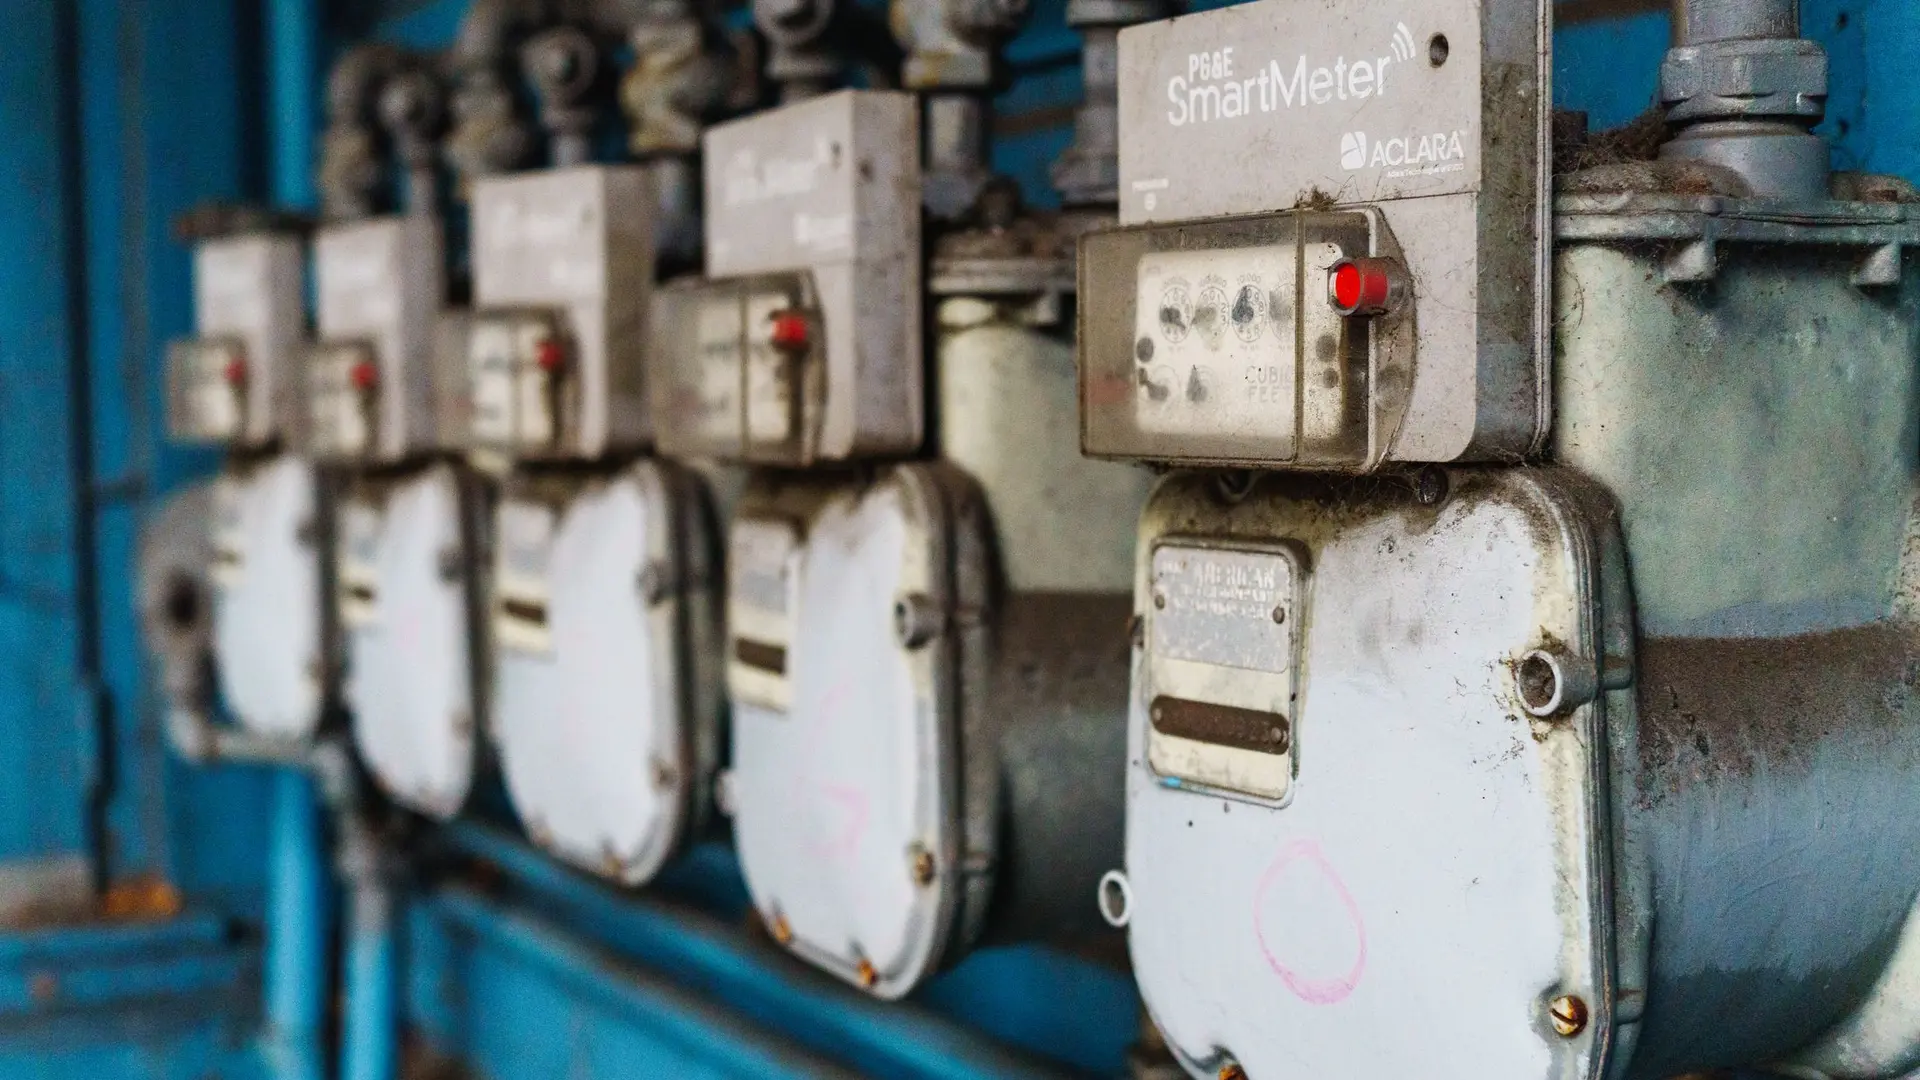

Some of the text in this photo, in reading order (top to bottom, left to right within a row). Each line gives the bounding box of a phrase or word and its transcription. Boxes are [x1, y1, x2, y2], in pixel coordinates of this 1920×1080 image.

[1189, 47, 1233, 82] PG&E
[1168, 55, 1391, 126] SmartMeter
[1370, 130, 1465, 167] ACLARA
